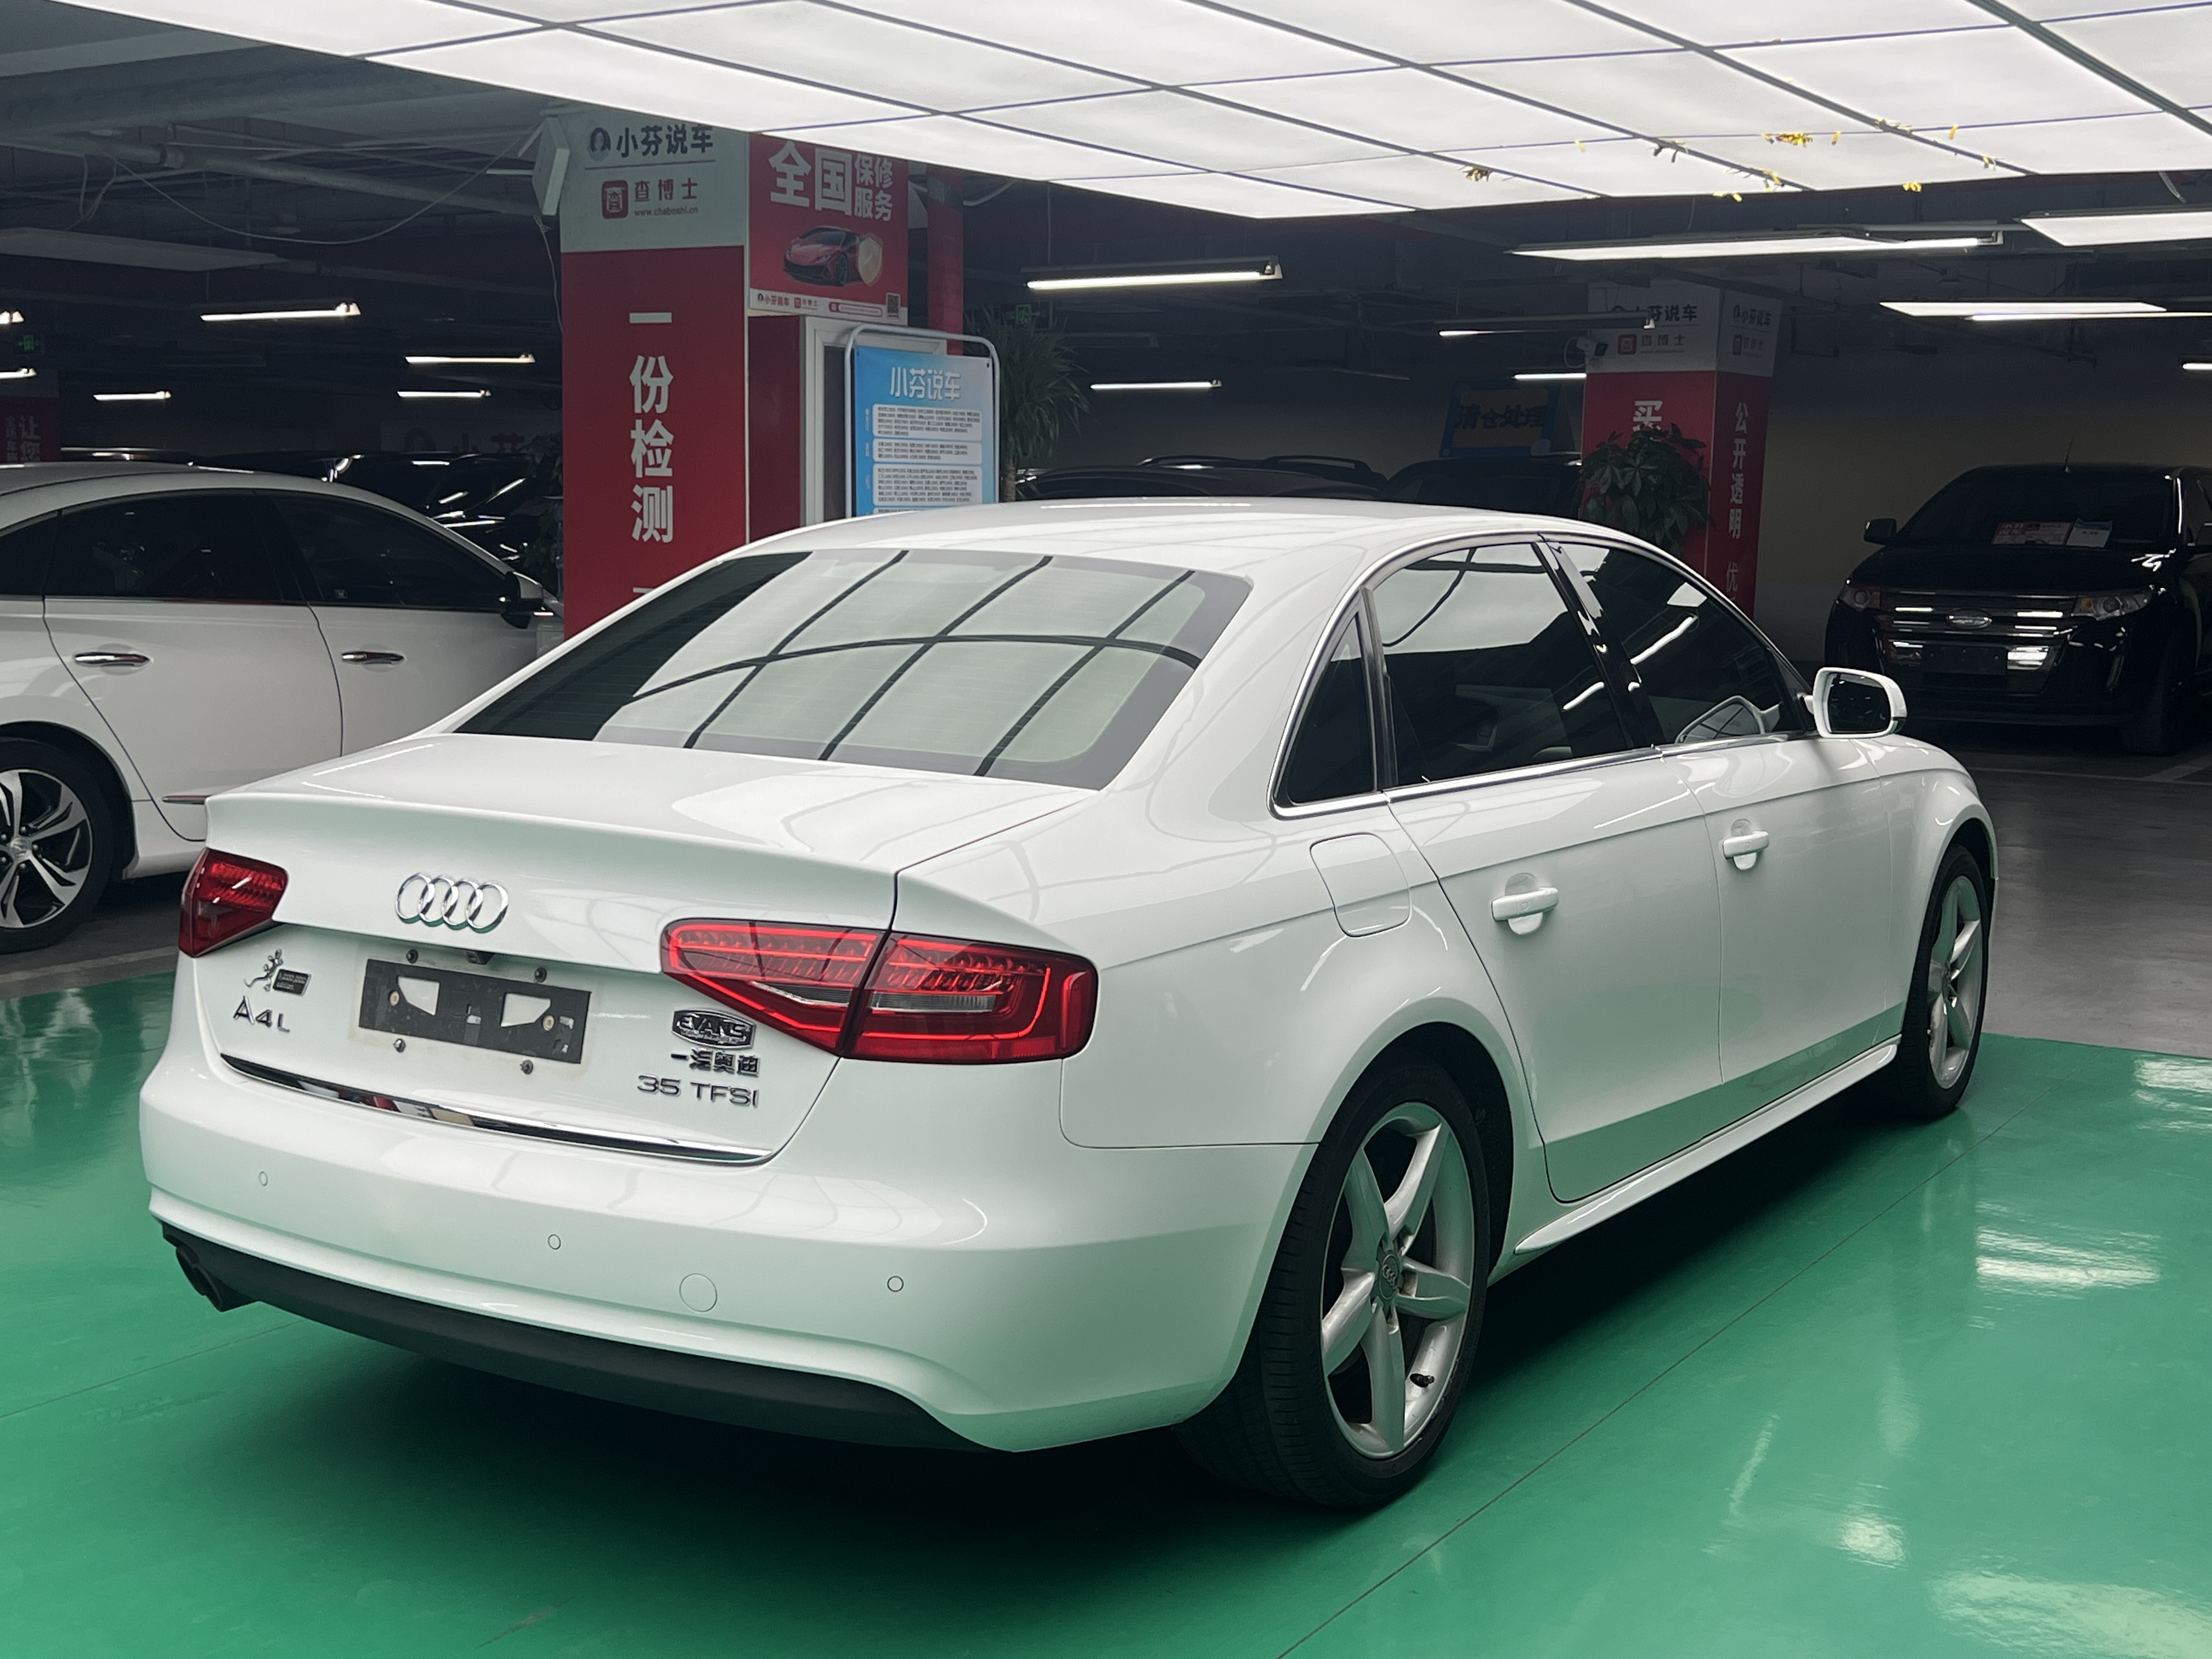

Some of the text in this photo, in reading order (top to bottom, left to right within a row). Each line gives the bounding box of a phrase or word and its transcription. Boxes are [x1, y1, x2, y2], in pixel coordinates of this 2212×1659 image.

[616, 123, 713, 158] 小芬说车
[769, 140, 853, 216] 全国
[854, 154, 893, 189] 保修
[634, 177, 698, 202] 查博士
[854, 187, 893, 222] 服务
[1633, 304, 1698, 323] 芬说车
[889, 365, 961, 401] 小芬说车
[629, 312, 674, 543] 一份检测
[233, 996, 291, 1033] A4L
[676, 1013, 751, 1042] EVANS
[670, 1046, 761, 1077] 一汽奥迪
[637, 1074, 760, 1108] 35 TFSI
